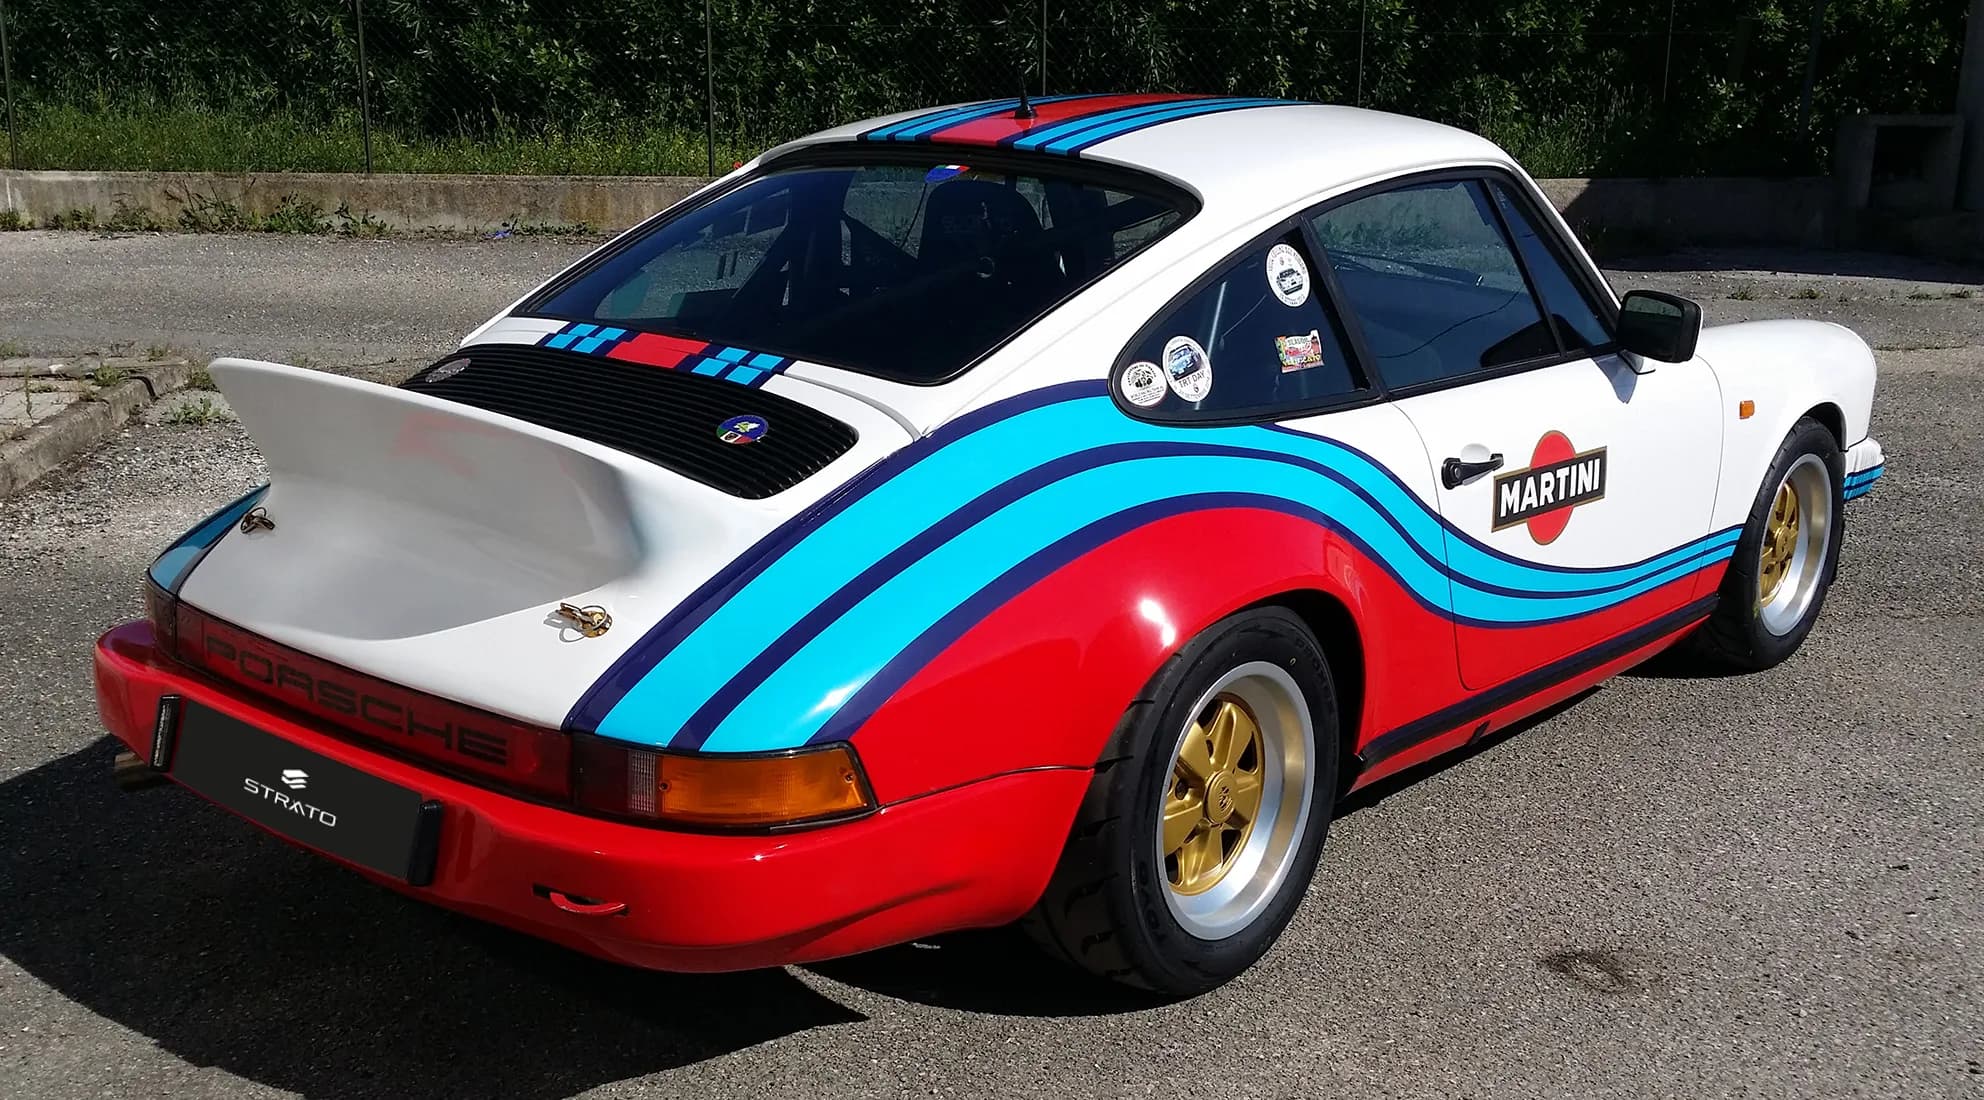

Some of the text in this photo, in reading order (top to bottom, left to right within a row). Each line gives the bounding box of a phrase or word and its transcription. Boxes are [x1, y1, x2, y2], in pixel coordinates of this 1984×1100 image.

[1191, 370, 1205, 382] DAY
[1500, 458, 1600, 517] MARTINI
[206, 636, 507, 767] PORSCHE
